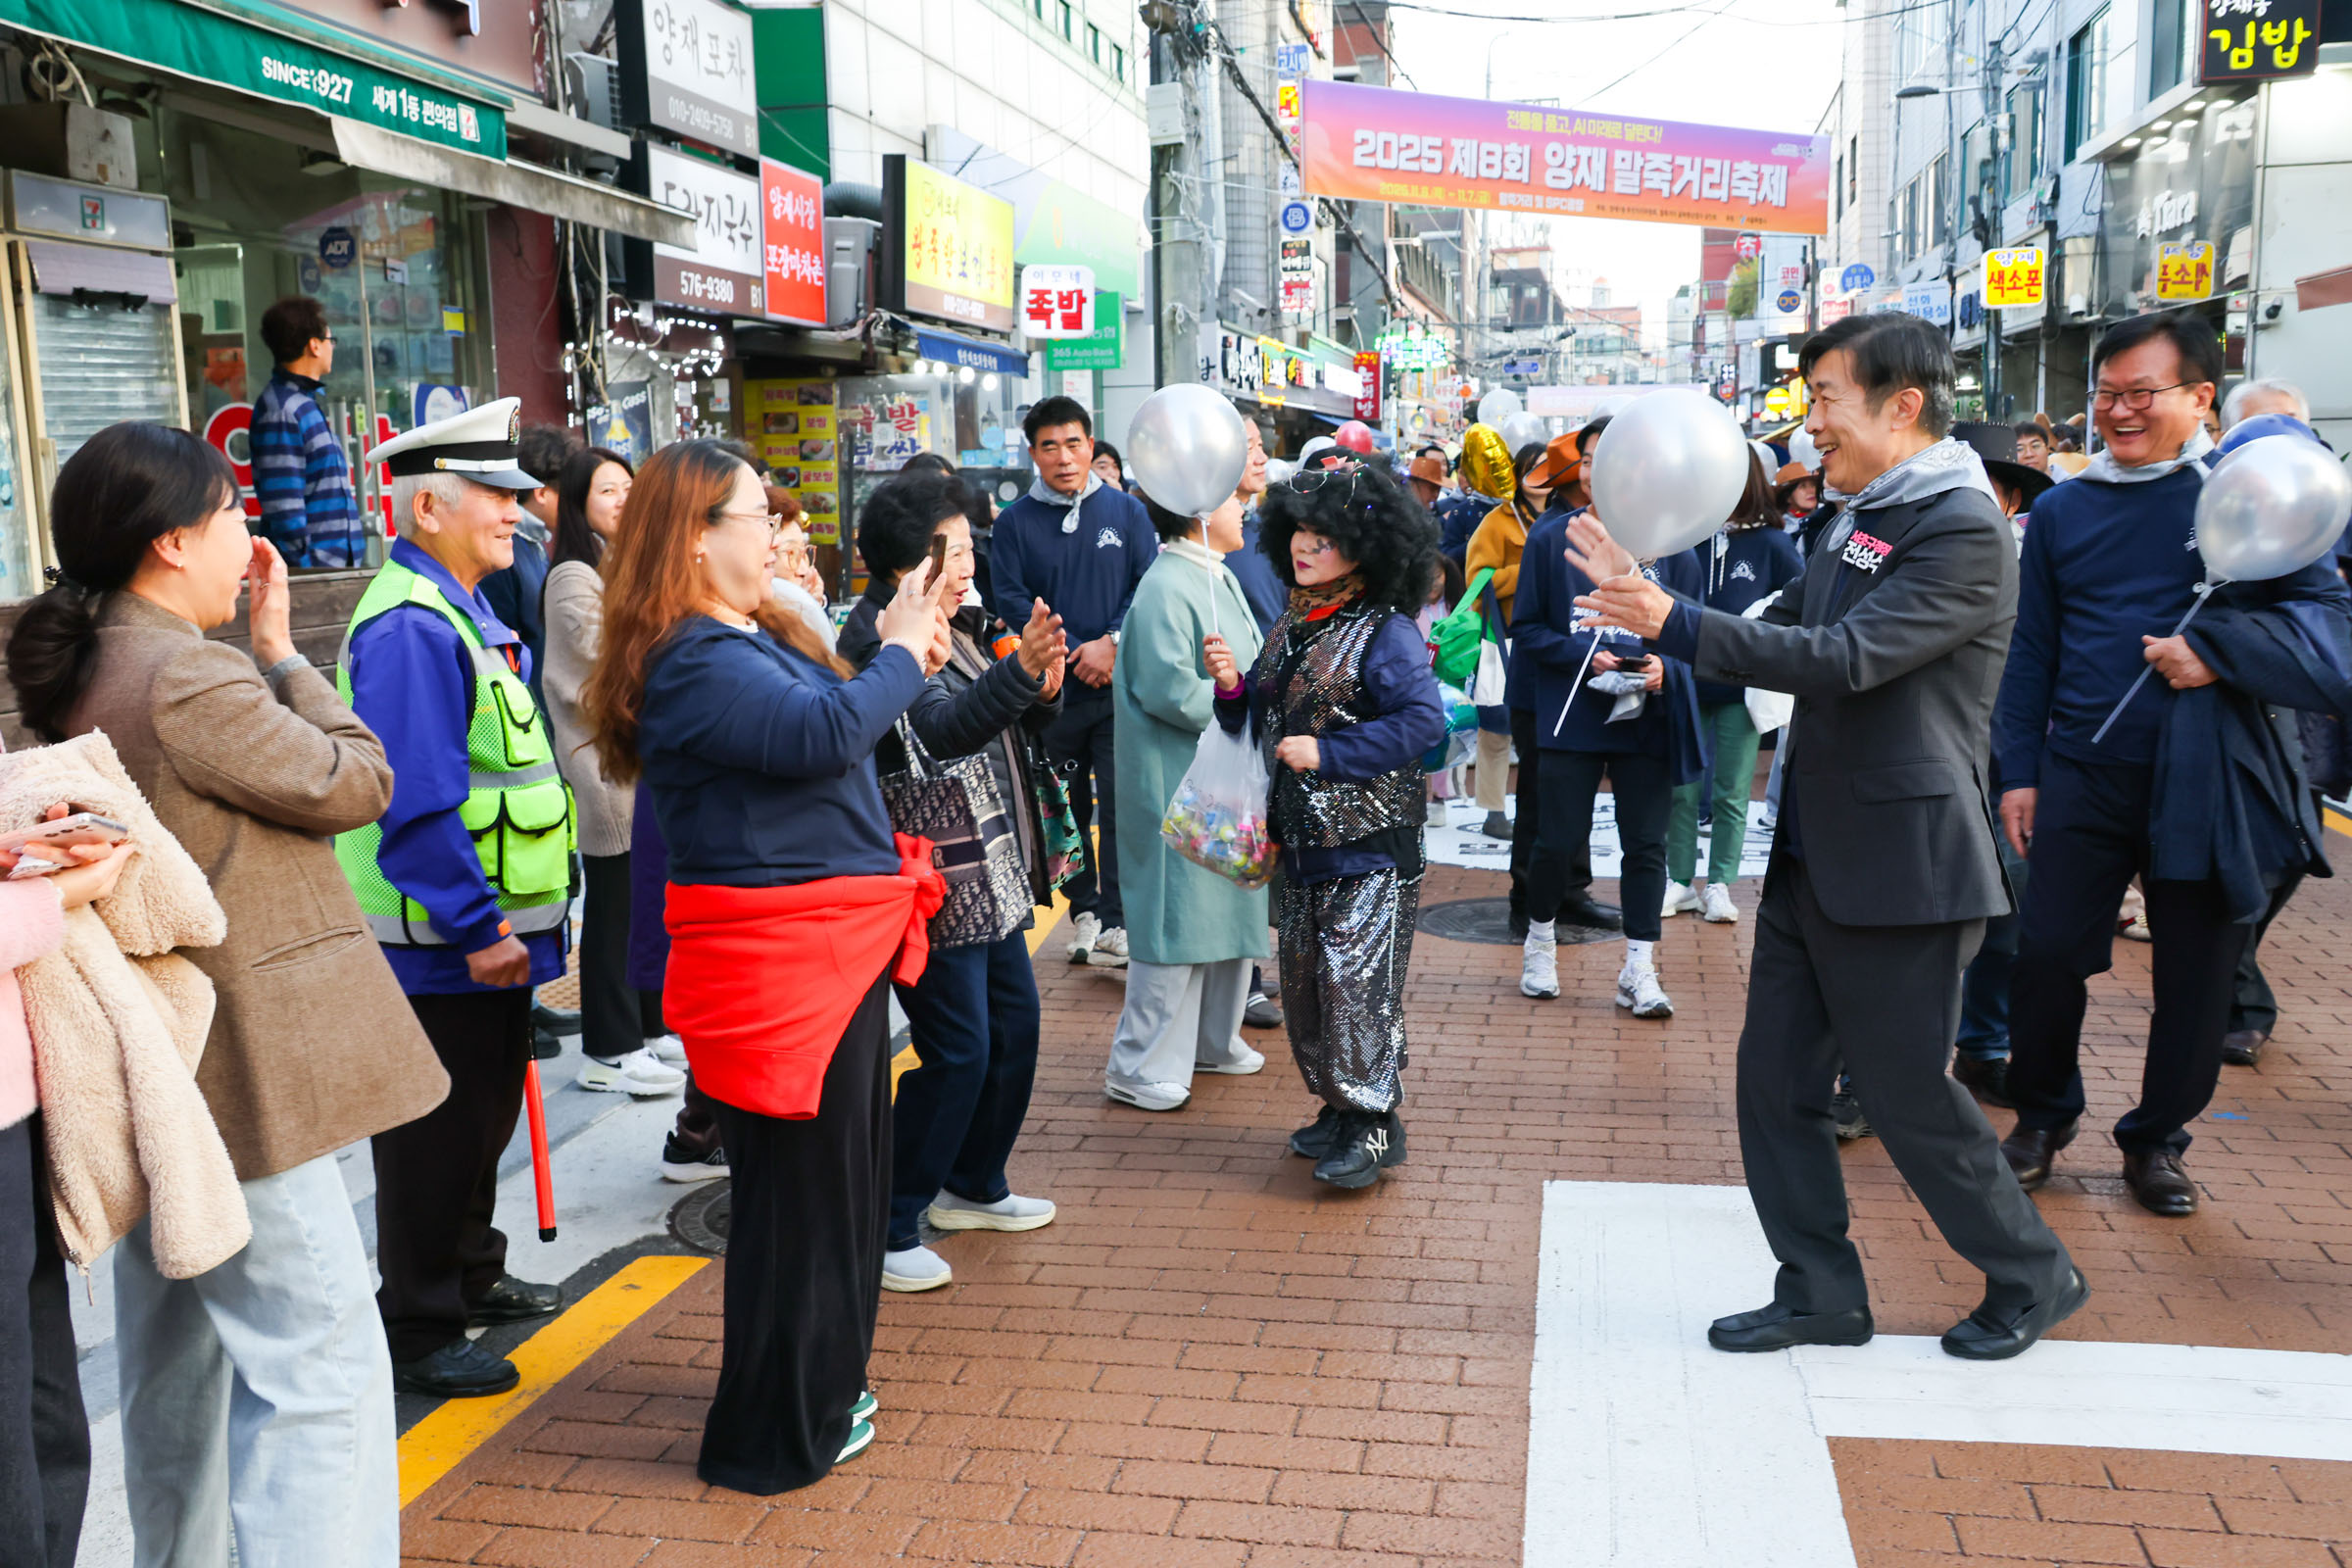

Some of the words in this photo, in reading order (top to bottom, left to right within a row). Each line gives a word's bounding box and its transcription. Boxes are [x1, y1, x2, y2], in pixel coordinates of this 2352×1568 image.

[654, 2, 746, 94] 양재포차
[2209, 17, 2312, 70] 김밥
[262, 56, 311, 90] SINCE
[372, 85, 397, 116] 세계
[399, 88, 420, 122] 1등
[421, 100, 458, 132] 편의점
[1507, 110, 1544, 132] 전통을
[1573, 118, 1587, 135] AI
[1588, 119, 1623, 139] 미래로
[1624, 122, 1663, 144] 달린다!
[1353, 128, 1444, 174] 2025
[1448, 137, 1531, 184] 제8회
[1544, 141, 1607, 193] 양재
[1614, 149, 1788, 208] 말죽거리축제
[769, 185, 815, 230] 양재시장
[325, 240, 350, 255] ADT
[1995, 252, 2035, 267] 양재
[766, 244, 823, 286] 포장마차촌
[680, 270, 734, 304] 576-9380
[750, 285, 762, 308] B1
[1987, 270, 2042, 298] 색소폰
[1026, 289, 1087, 330] 족발
[1842, 540, 1884, 574] 전성수
[1850, 530, 1893, 557] 서초구청장
